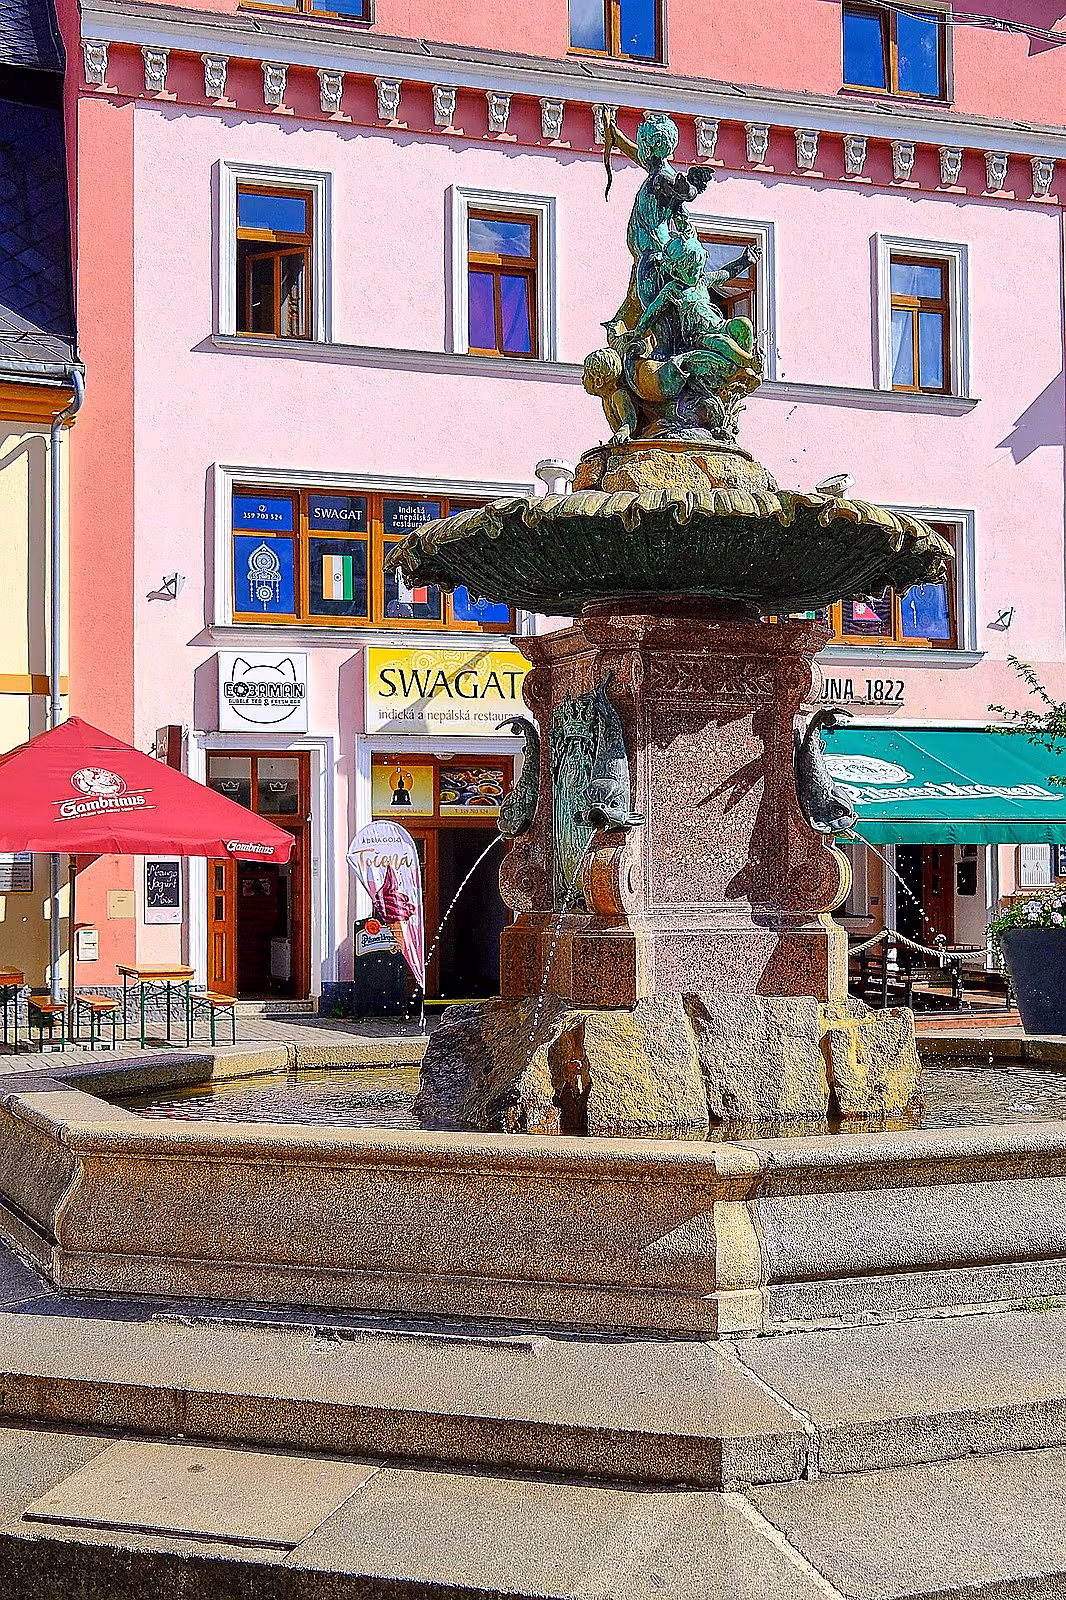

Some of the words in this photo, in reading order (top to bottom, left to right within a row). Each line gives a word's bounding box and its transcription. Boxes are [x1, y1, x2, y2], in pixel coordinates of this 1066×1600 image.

[313, 507, 363, 521] SWAGAT
[378, 668, 524, 699] SWAGAT
[865, 679, 905, 701] 1822
[263, 698, 270, 706] &
[378, 708, 414, 720] indická
[417, 712, 424, 720] a
[427, 709, 470, 723] nepálská
[60, 795, 146, 818] Gambrinus
[226, 839, 275, 855] Gambrinus
[351, 847, 413, 872] Točená
[150, 892, 174, 905] Mix
